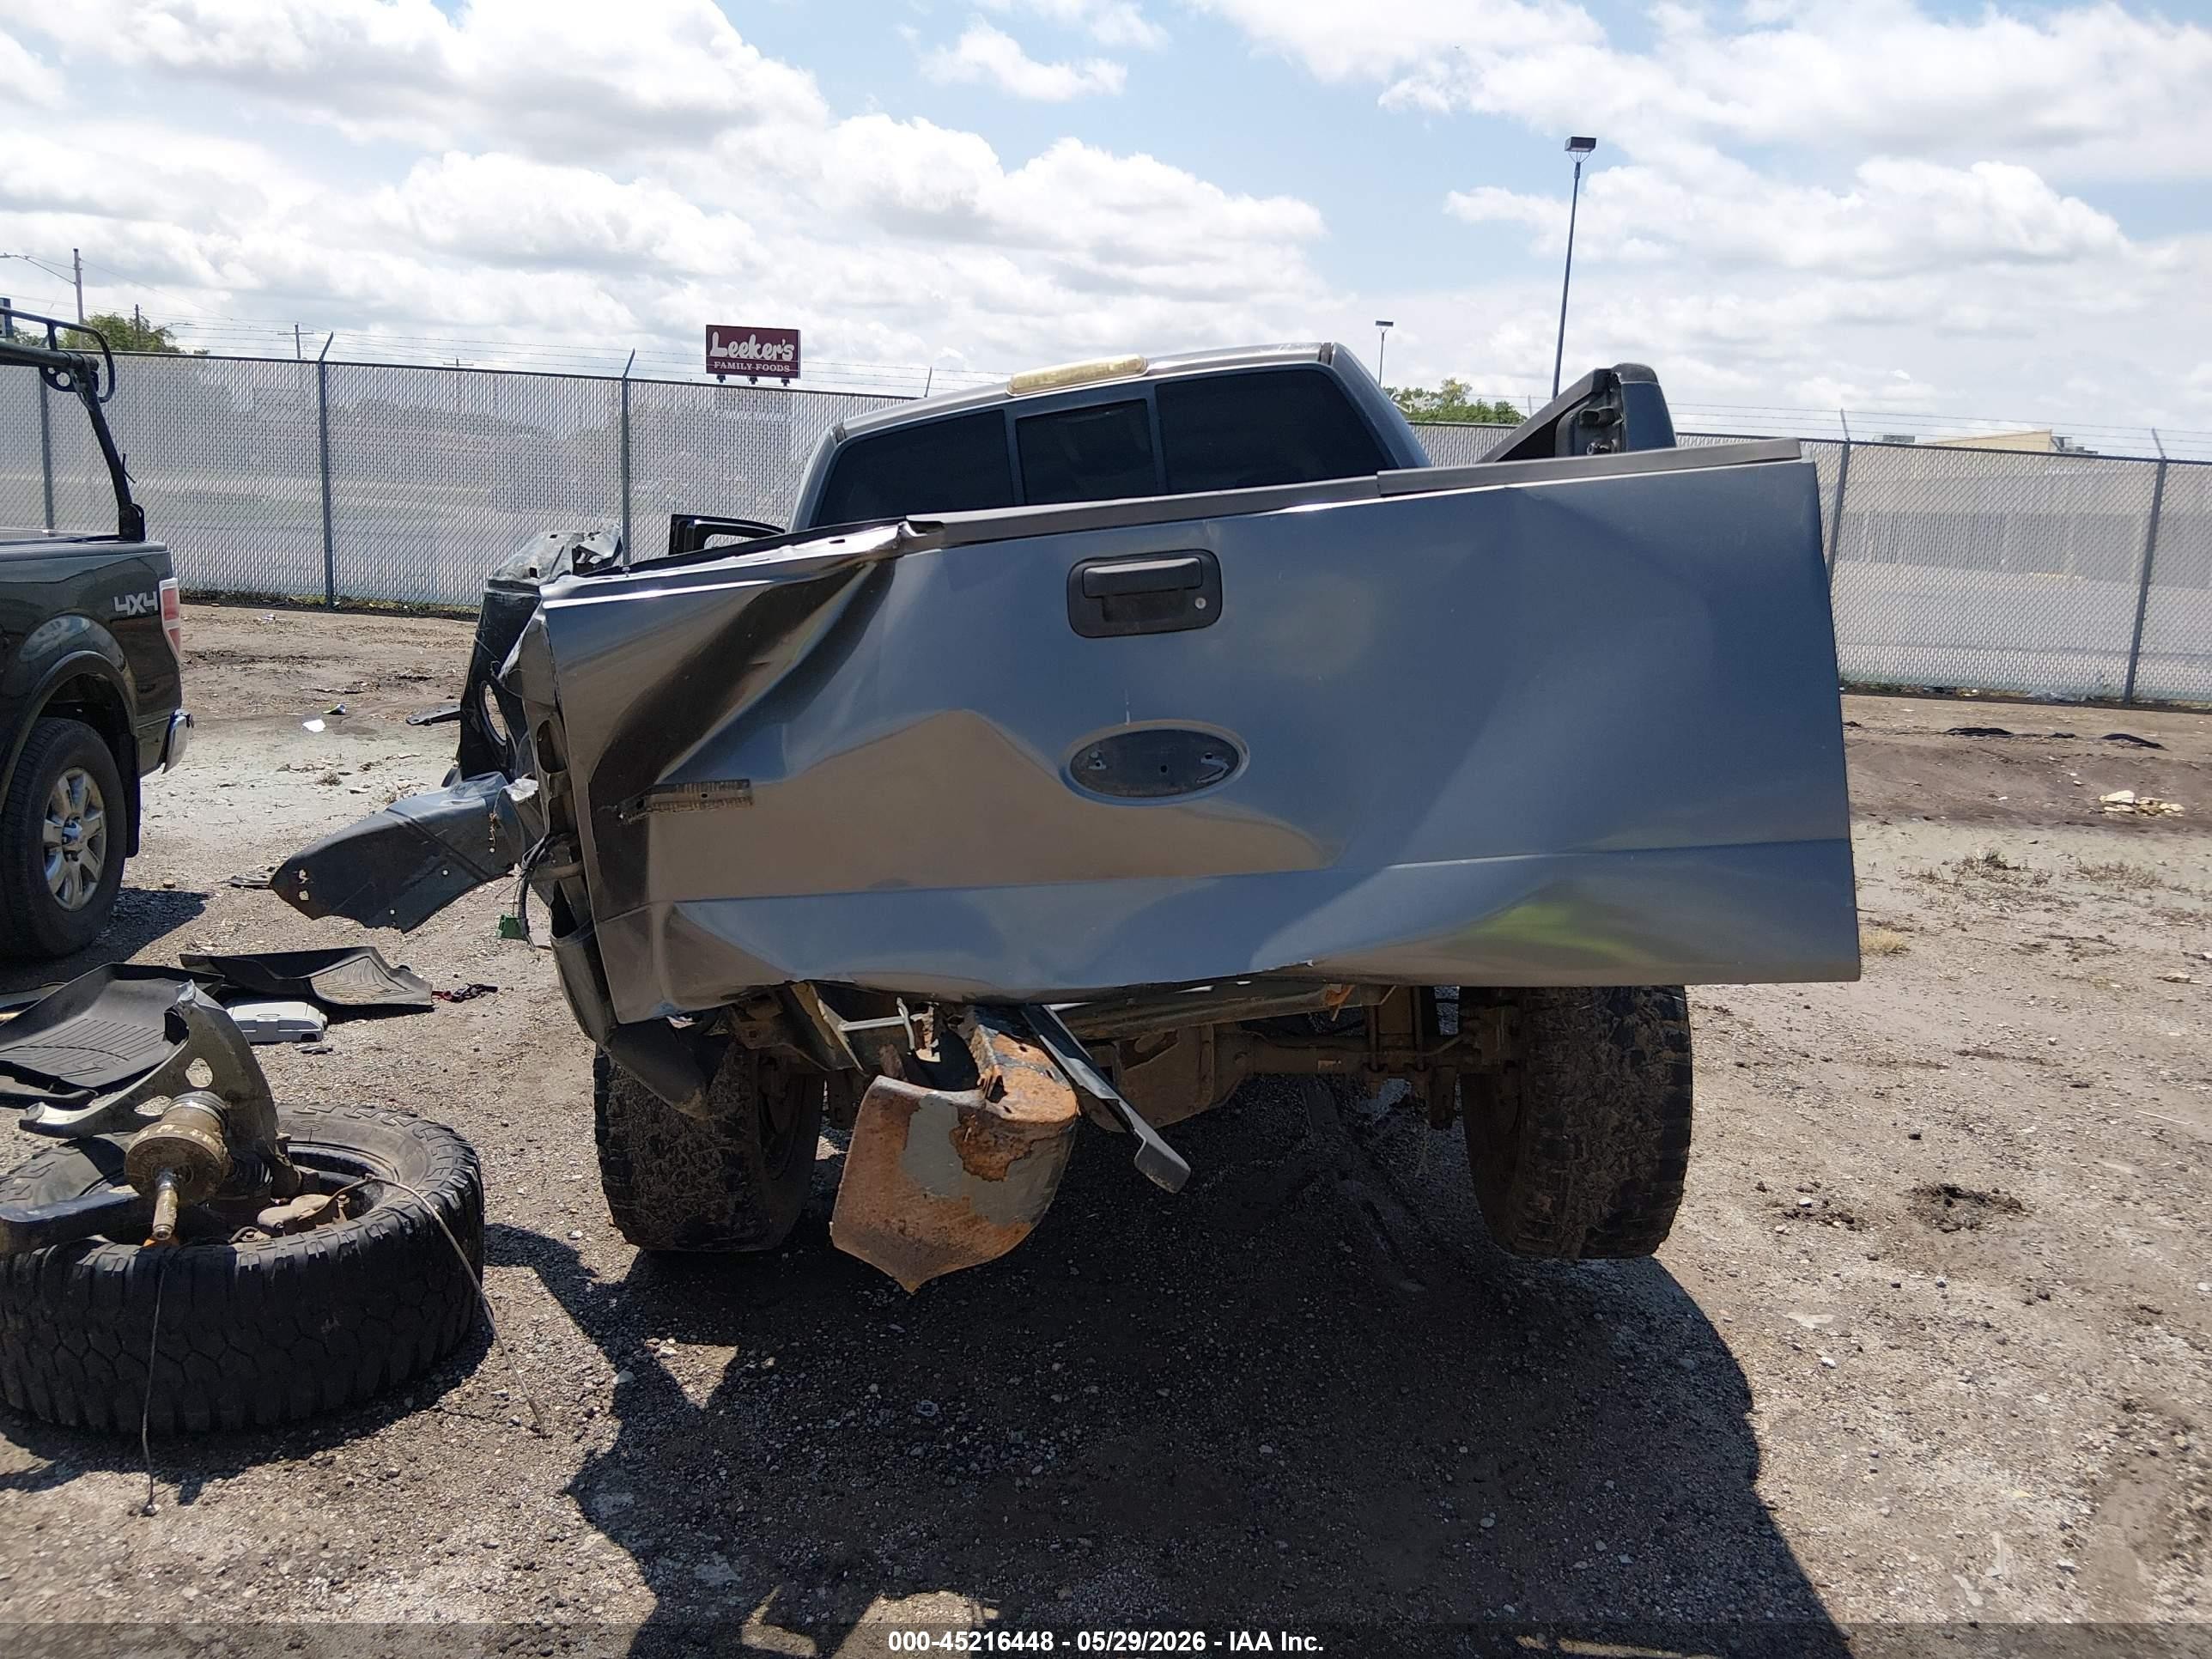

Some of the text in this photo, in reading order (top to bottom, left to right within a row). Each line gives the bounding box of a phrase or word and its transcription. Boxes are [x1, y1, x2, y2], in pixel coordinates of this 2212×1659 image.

[710, 331, 795, 362] Leeker's
[714, 361, 791, 373] FAMILY FOODS
